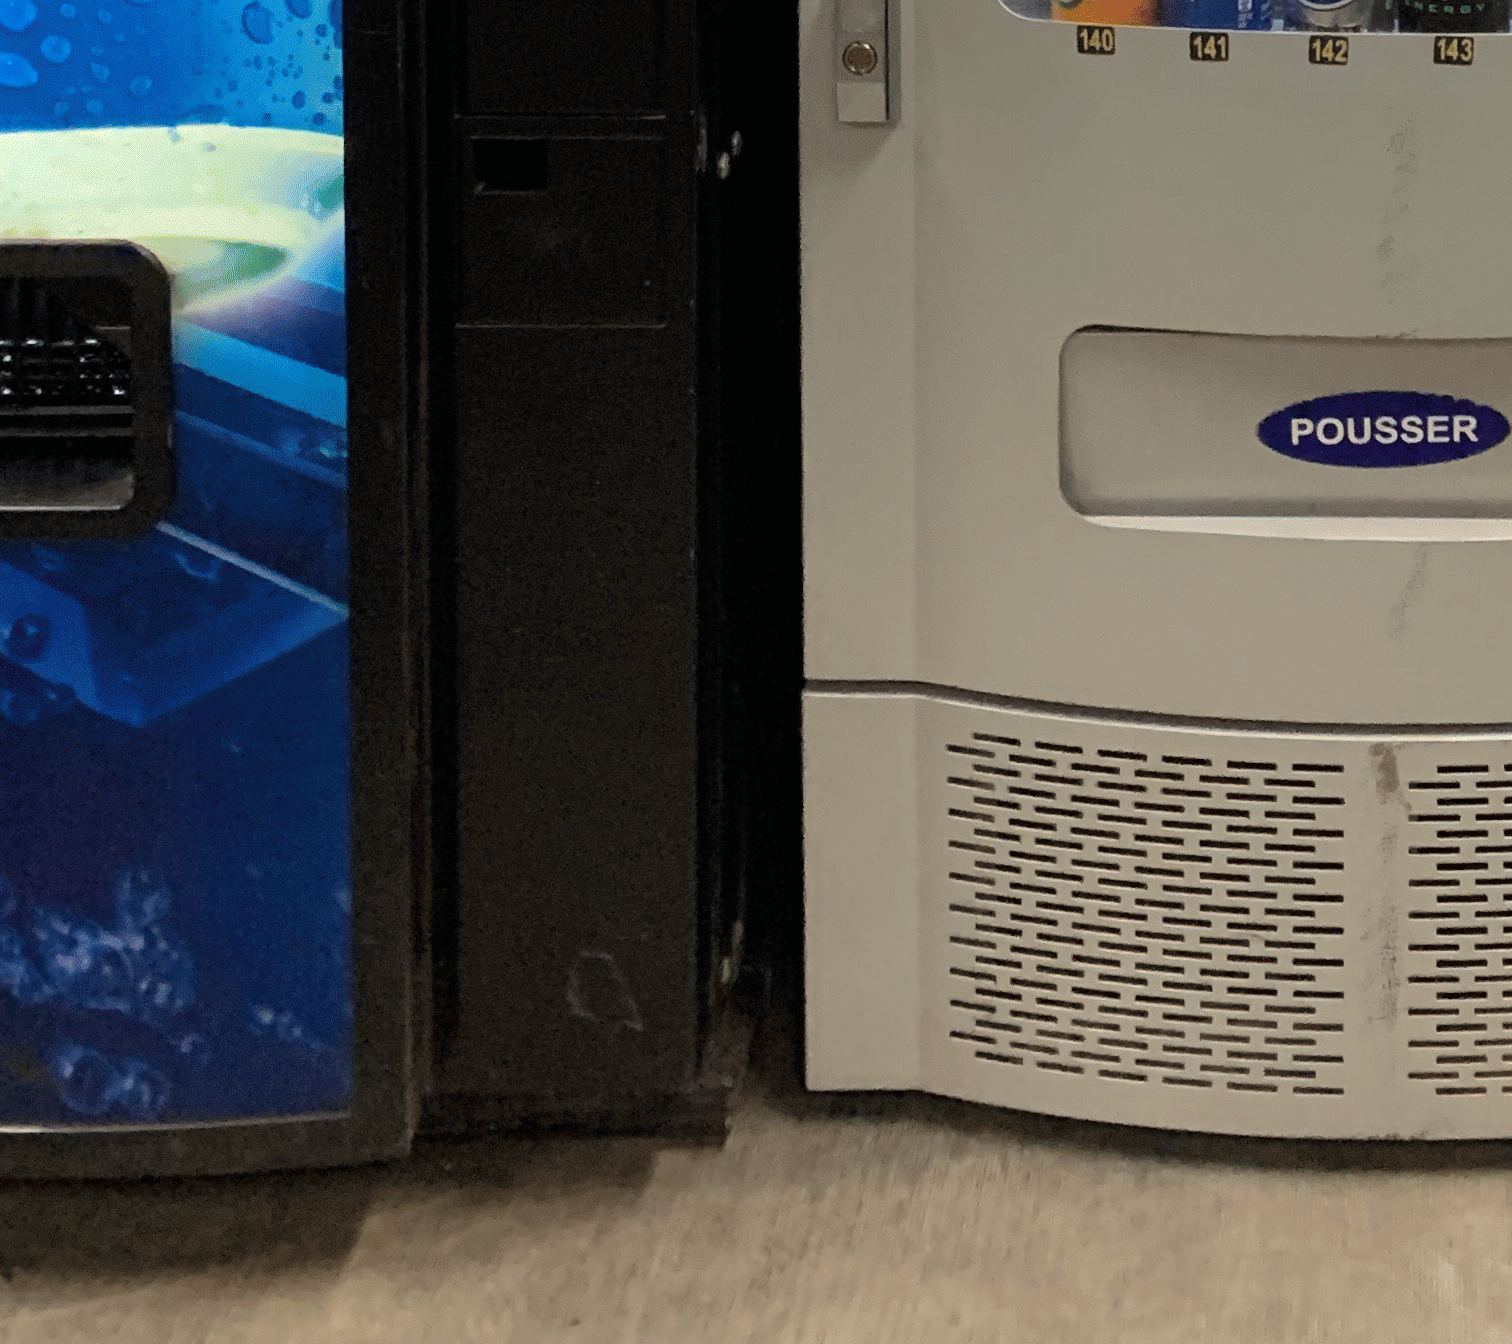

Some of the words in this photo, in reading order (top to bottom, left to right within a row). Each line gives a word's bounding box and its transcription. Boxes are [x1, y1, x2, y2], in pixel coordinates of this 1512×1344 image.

[1079, 29, 1115, 52] 140
[1193, 35, 1228, 58] 141
[1312, 39, 1347, 62] 142
[1437, 39, 1473, 62] 143
[1290, 414, 1479, 446] POUSSER
